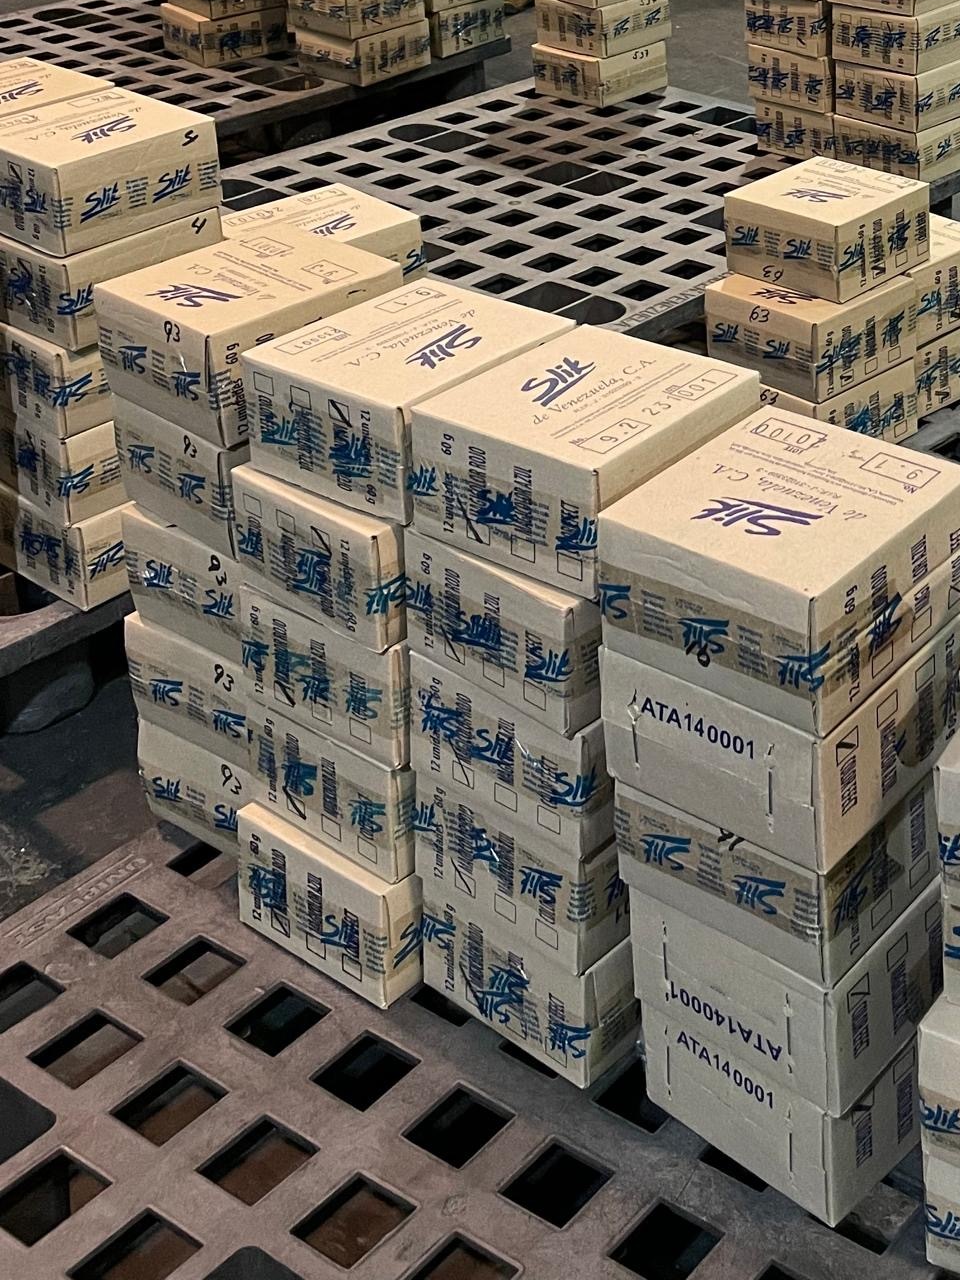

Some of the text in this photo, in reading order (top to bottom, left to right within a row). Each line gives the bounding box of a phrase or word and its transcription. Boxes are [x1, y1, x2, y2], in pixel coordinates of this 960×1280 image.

[72, 115, 136, 144] Slik
[153, 164, 192, 203] Slik
[80, 182, 122, 224] Slik
[732, 225, 760, 246] Slik
[784, 238, 812, 259] Slik
[57, 283, 94, 315] Slik
[145, 283, 243, 308] Slik
[406, 324, 482, 369] Slik
[712, 322, 739, 342] Slik
[763, 340, 790, 359] Slik
[232, 377, 248, 422] unidades
[521, 357, 595, 407] Slik
[532, 412, 549, 426] de
[548, 375, 625, 421] Venezuela,
[441, 443, 452, 456] 60
[757, 477, 841, 516] Venezuela,
[443, 521, 454, 534] 12
[691, 497, 824, 536] Slik
[201, 589, 235, 619] Slik
[679, 618, 729, 655] Slik
[525, 649, 573, 682] Slik
[641, 696, 755, 760] ATA140001
[152, 777, 182, 802] Slik
[214, 804, 239, 832] Sli
[640, 833, 691, 870] Slik
[732, 875, 786, 915] Slik
[671, 982, 783, 1062] ATA140001
[677, 1031, 775, 1109] ATA140001
